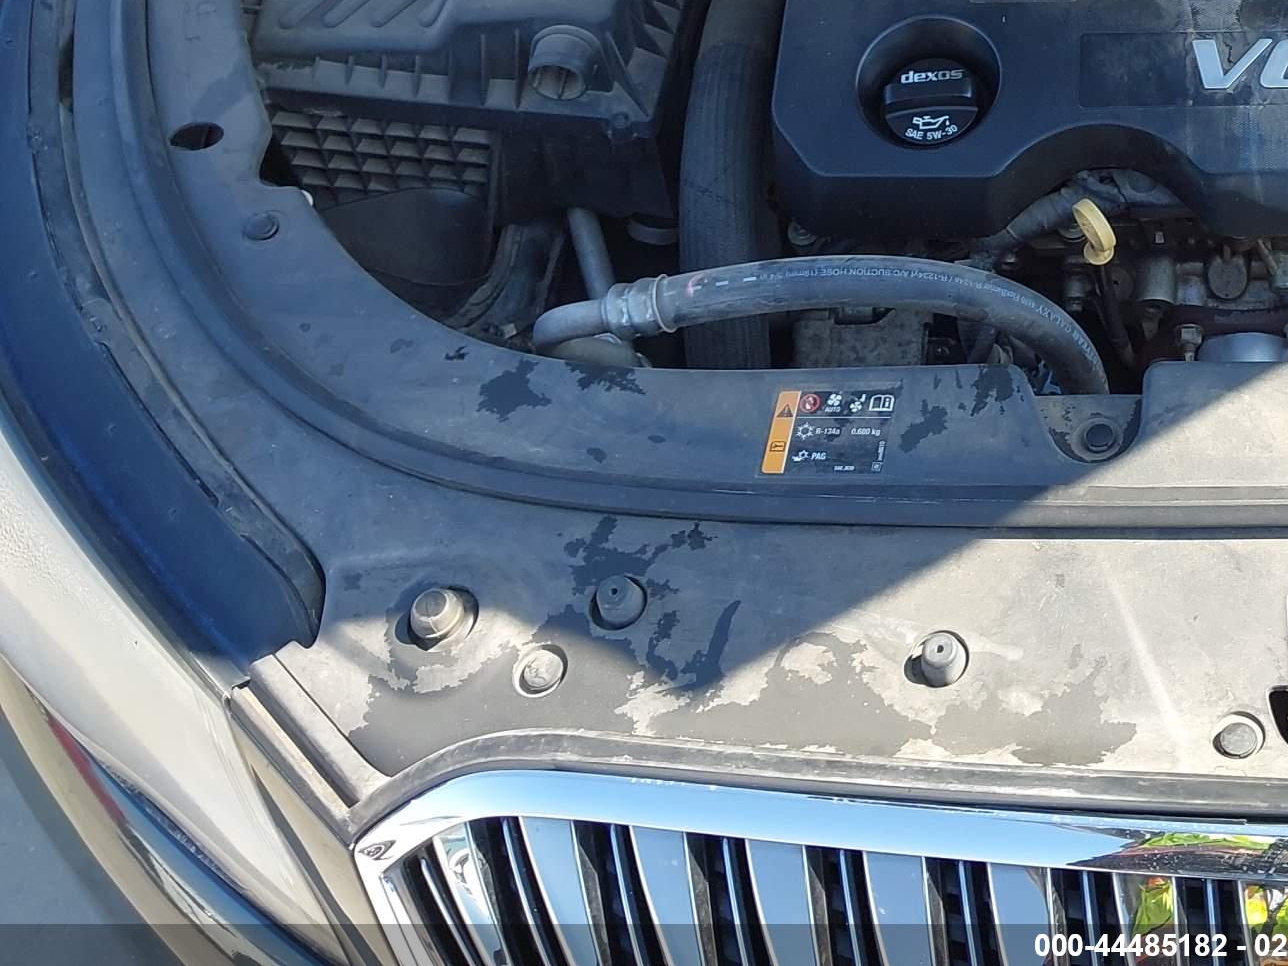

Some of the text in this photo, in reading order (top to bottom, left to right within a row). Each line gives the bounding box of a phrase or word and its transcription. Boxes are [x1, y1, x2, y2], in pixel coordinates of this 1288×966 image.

[900, 69, 965, 84] dexos
[905, 125, 958, 141] SAE 5W-30
[819, 267, 847, 277] HOSE
[849, 267, 890, 277] SUCTION
[815, 427, 841, 435] R-134a
[871, 428, 881, 437] kg
[810, 451, 827, 461] PAG
